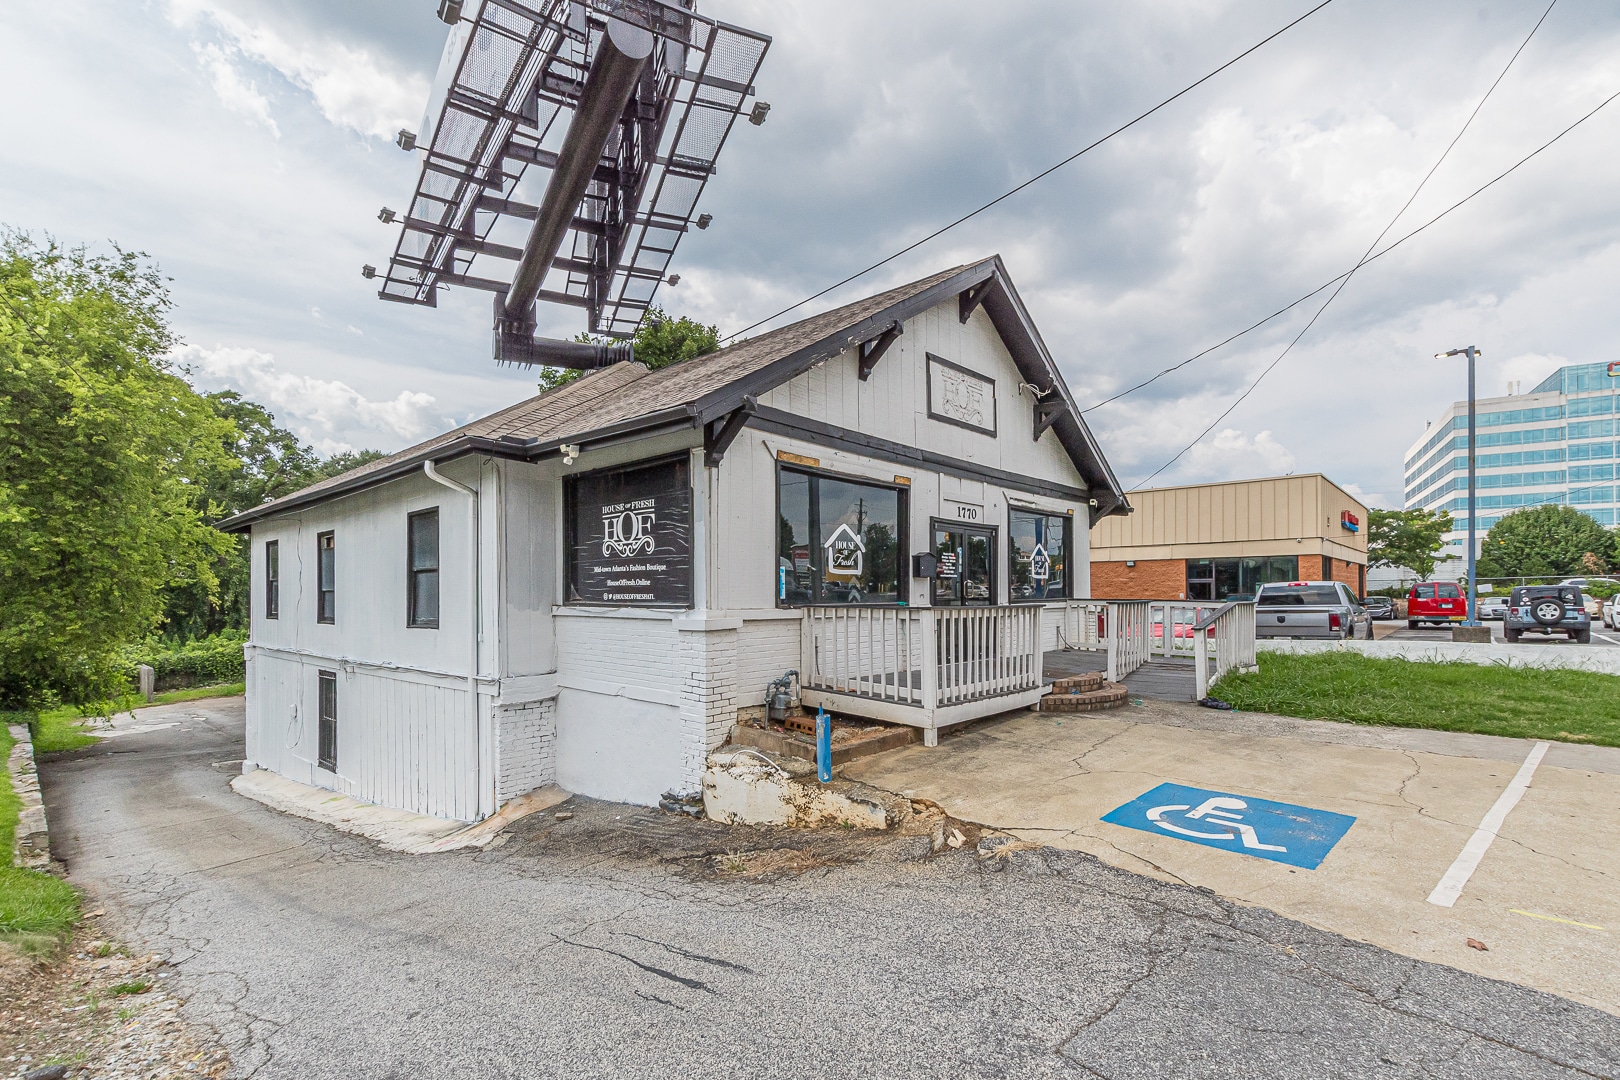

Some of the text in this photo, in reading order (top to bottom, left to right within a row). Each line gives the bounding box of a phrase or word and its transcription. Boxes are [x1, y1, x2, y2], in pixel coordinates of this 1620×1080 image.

[602, 503, 624, 513] HOUSE
[631, 499, 655, 509] FRESH
[957, 506, 977, 520] 1770
[602, 511, 656, 543] HOF
[835, 540, 857, 550] HOUSE
[832, 552, 857, 566] Fresh
[630, 563, 646, 572] Fashion
